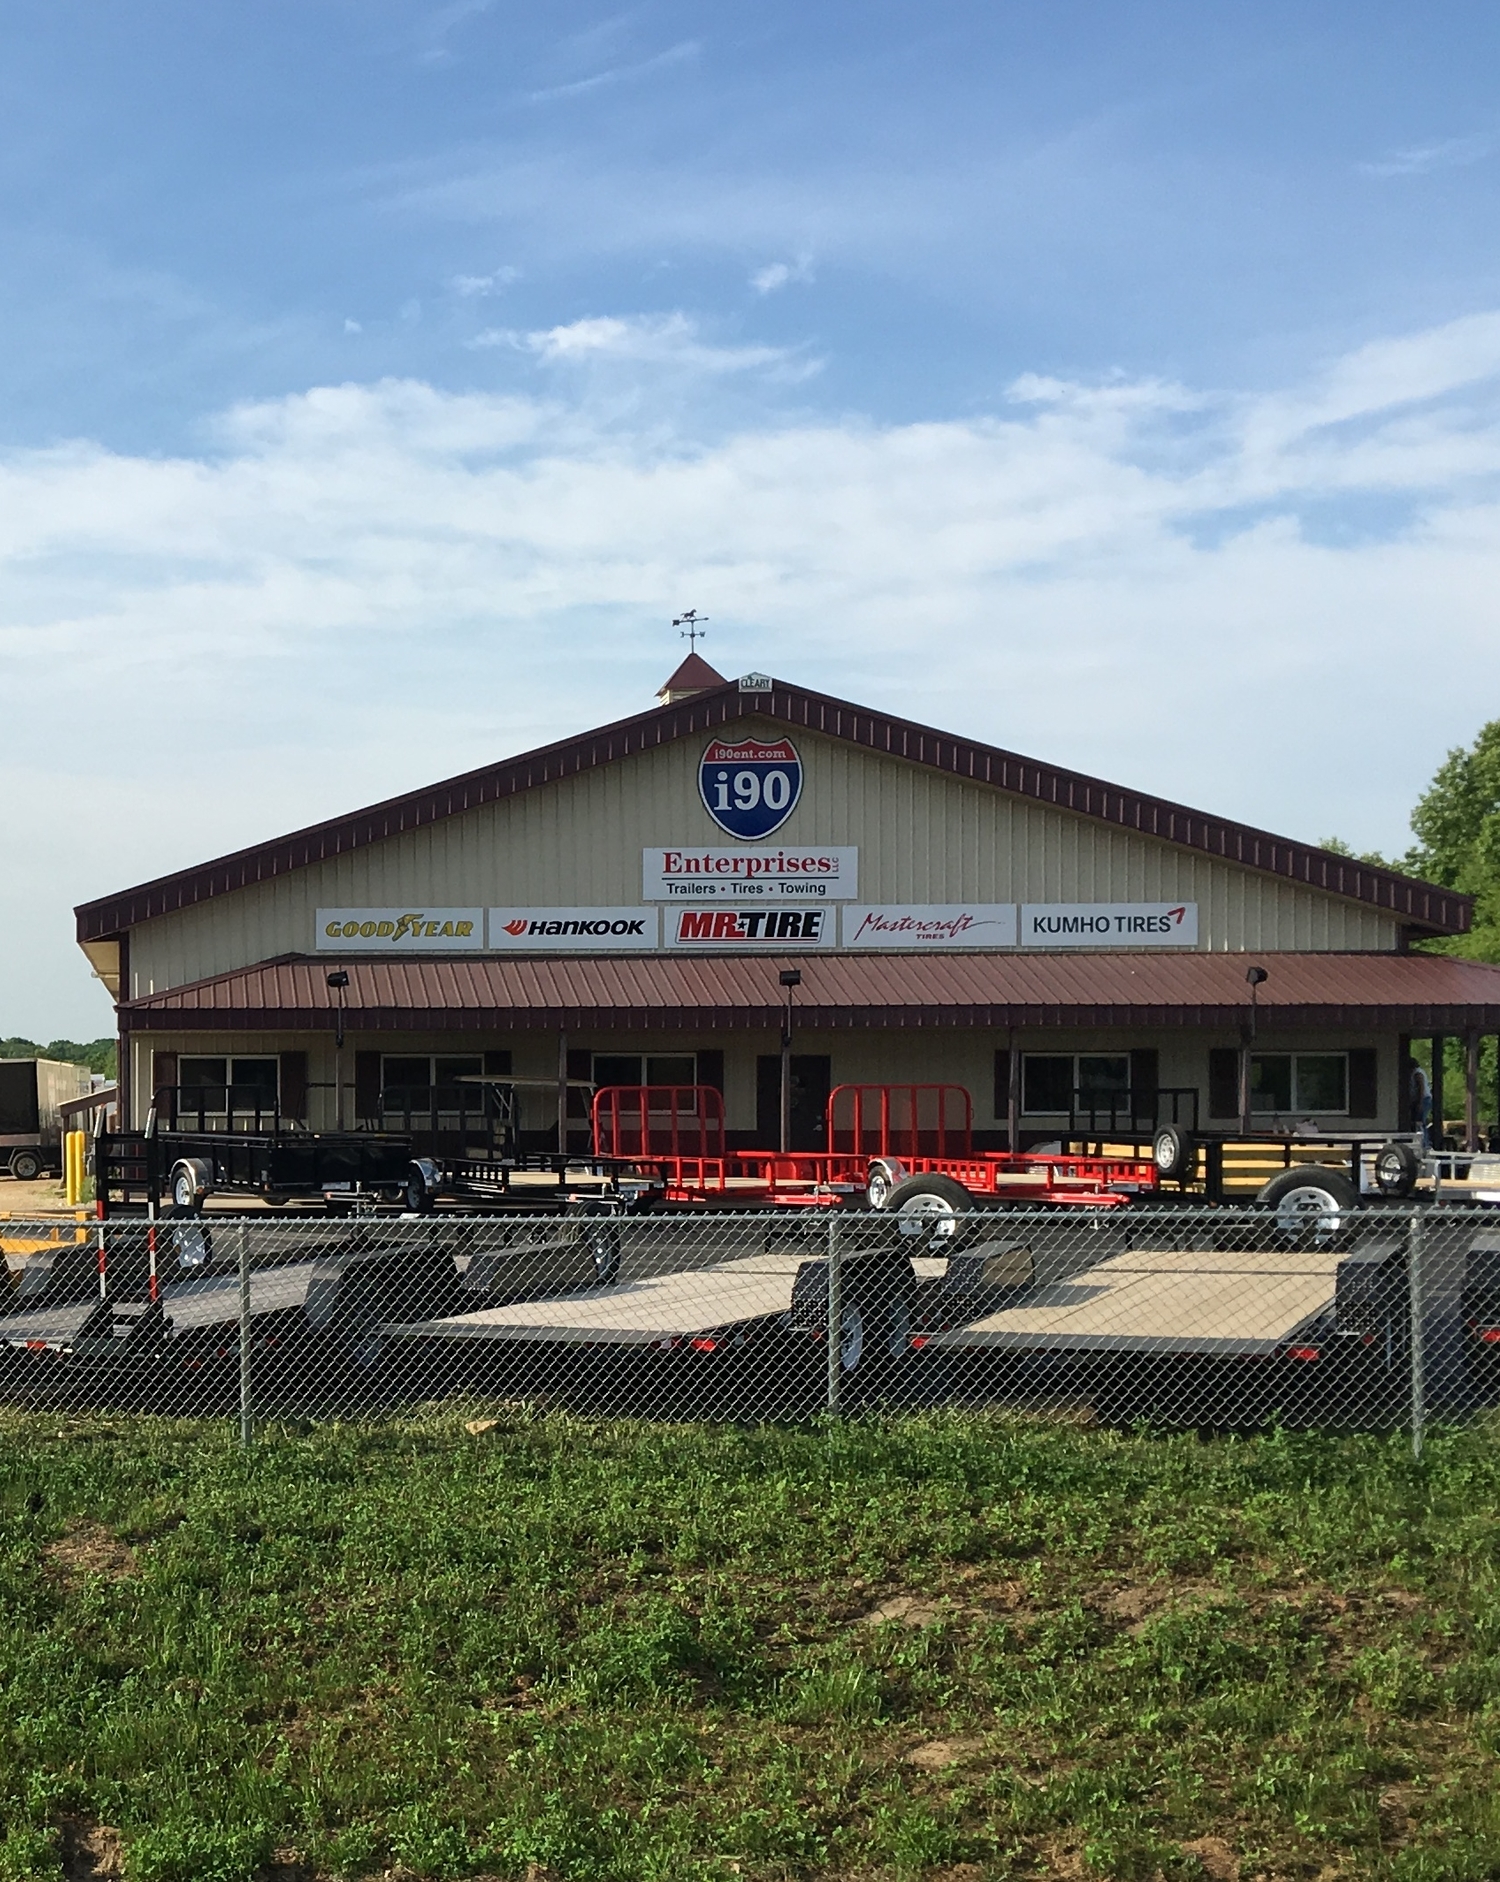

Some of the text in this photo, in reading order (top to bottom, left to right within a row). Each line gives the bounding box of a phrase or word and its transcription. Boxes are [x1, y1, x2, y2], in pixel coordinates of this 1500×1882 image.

[740, 679, 770, 688] CLEARY
[714, 749, 787, 759] i90ent.com
[713, 770, 791, 811] i90
[662, 851, 832, 878] Enterprises
[831, 857, 840, 872] LLC
[666, 882, 826, 896] Trailers Tires Towing
[854, 912, 986, 941] Mastercraft
[1033, 916, 1171, 933] KUMHO TIRES
